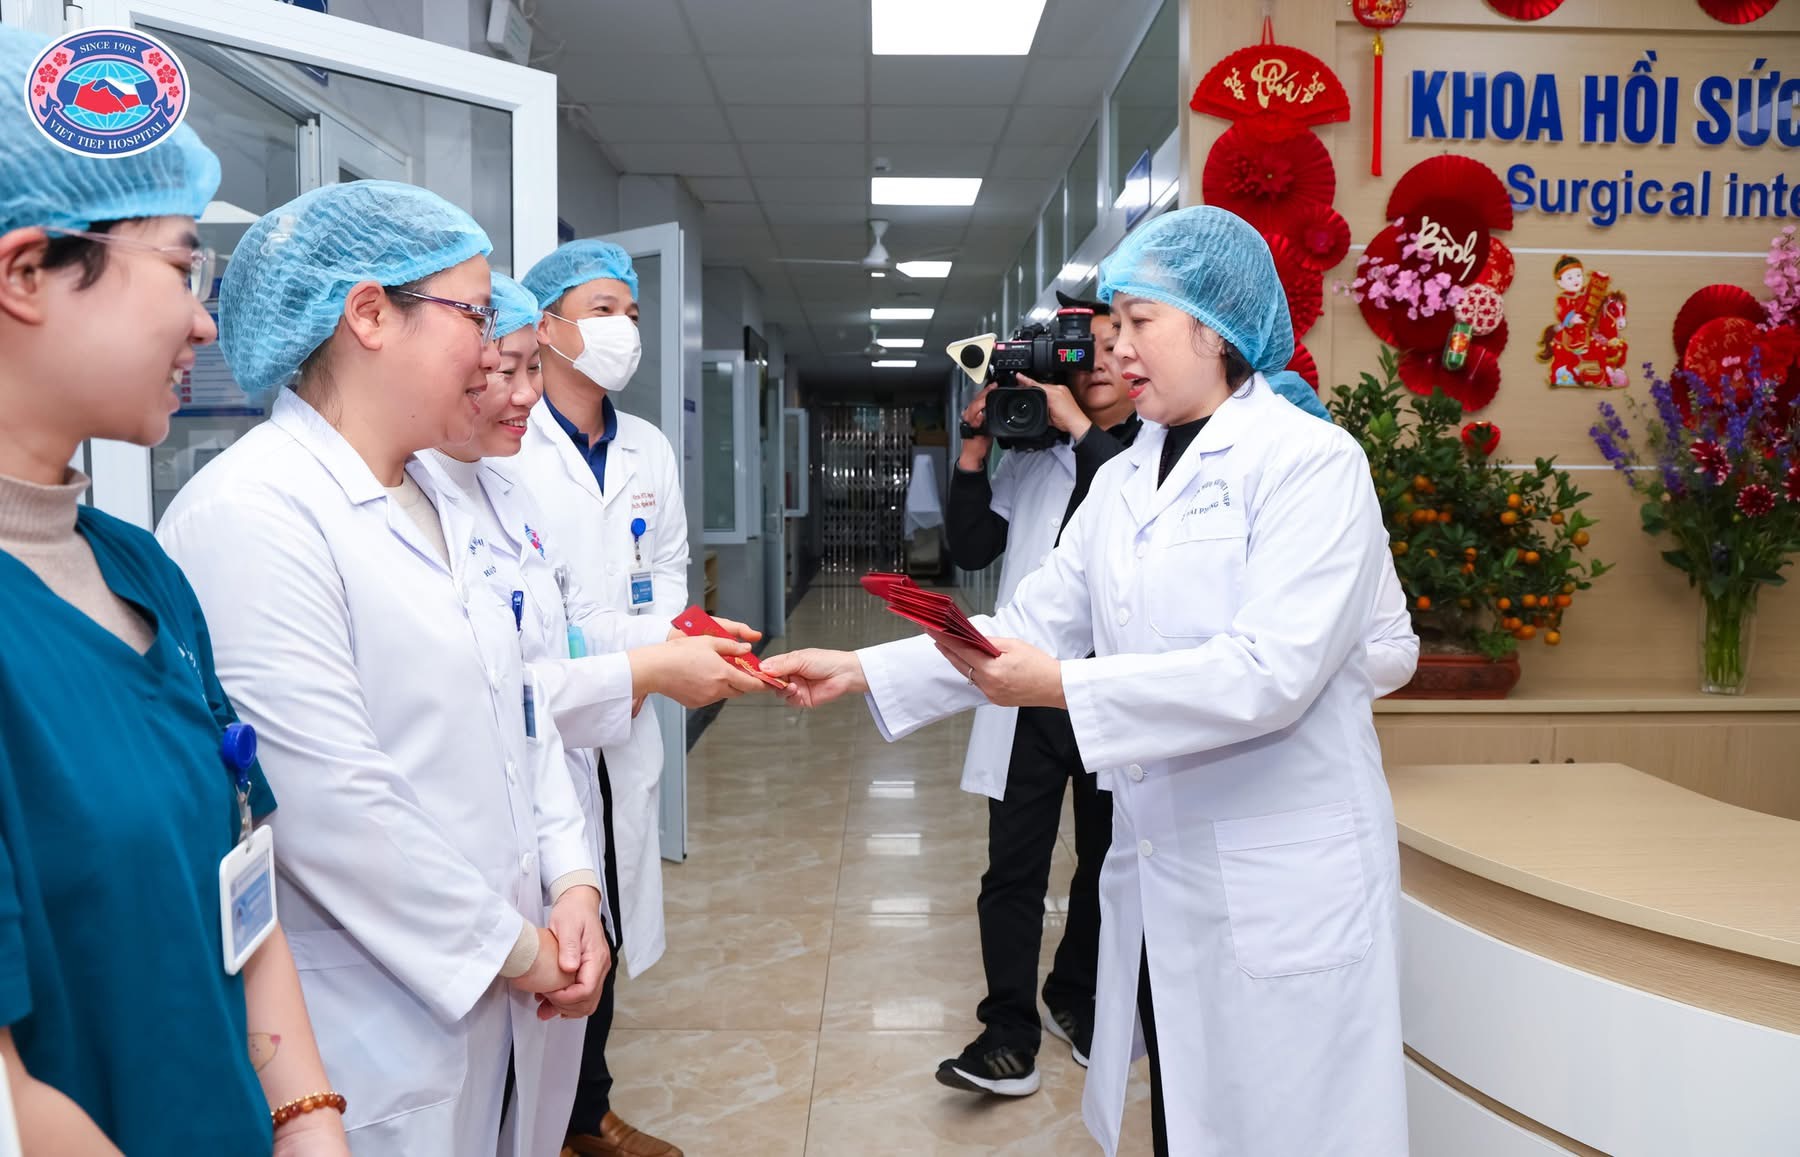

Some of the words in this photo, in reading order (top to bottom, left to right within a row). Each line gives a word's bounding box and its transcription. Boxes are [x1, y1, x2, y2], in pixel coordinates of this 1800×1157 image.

[1411, 69, 1563, 143] KHOA
[1583, 50, 1680, 145] HỒI
[1695, 57, 1800, 148] SỨC
[1506, 164, 1711, 227] Surgical
[1416, 215, 1478, 281] Bình
[1057, 348, 1085, 362] THP
